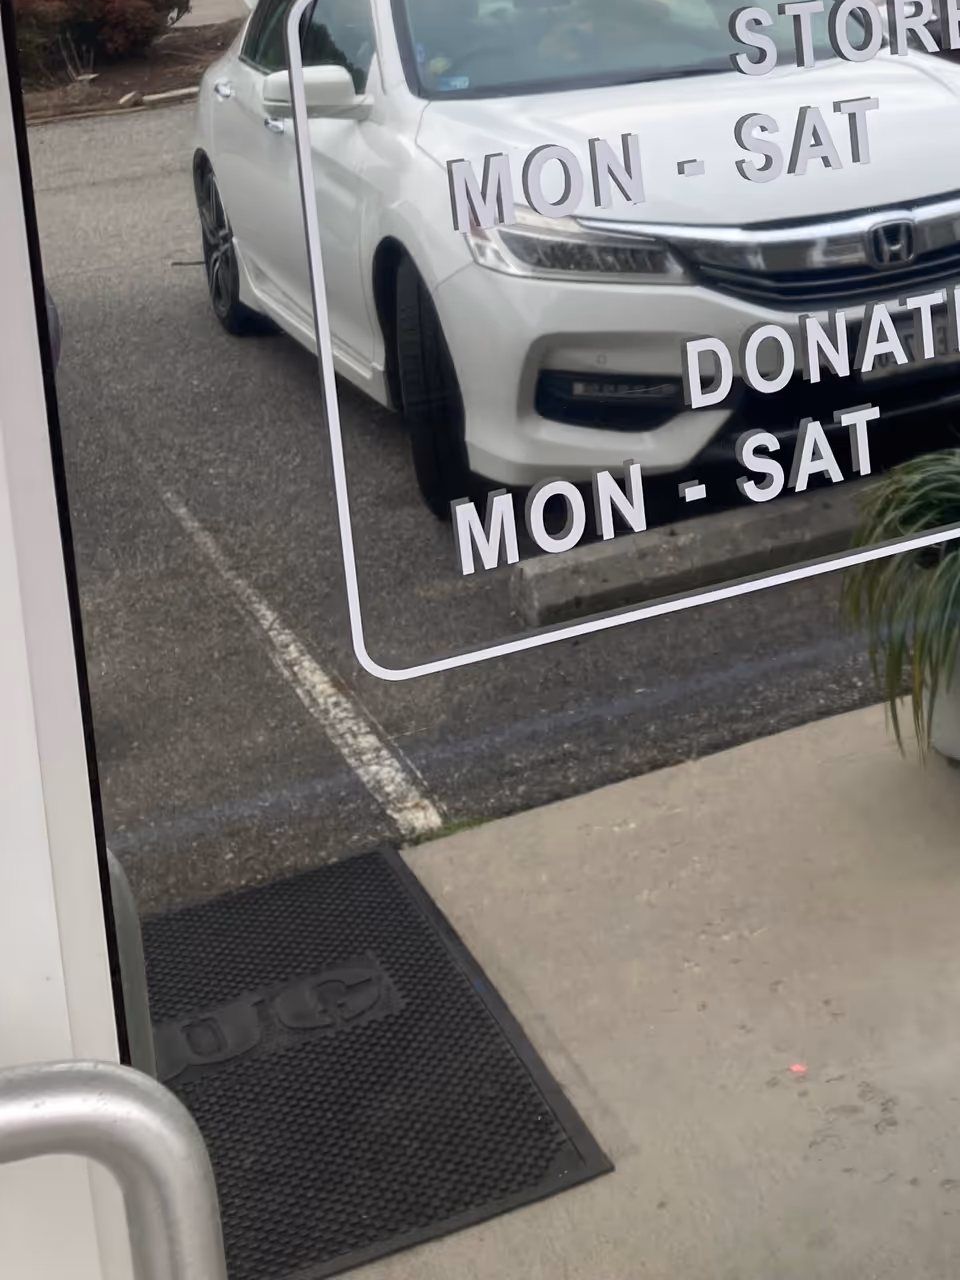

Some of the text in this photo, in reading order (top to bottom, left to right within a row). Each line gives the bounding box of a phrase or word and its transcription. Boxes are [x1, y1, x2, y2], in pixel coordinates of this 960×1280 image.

[449, 134, 644, 233] MON
[680, 160, 704, 176] -
[736, 97, 879, 183] SAT
[455, 463, 647, 575] MON
[685, 483, 706, 501] -
[743, 405, 880, 502] SAT
